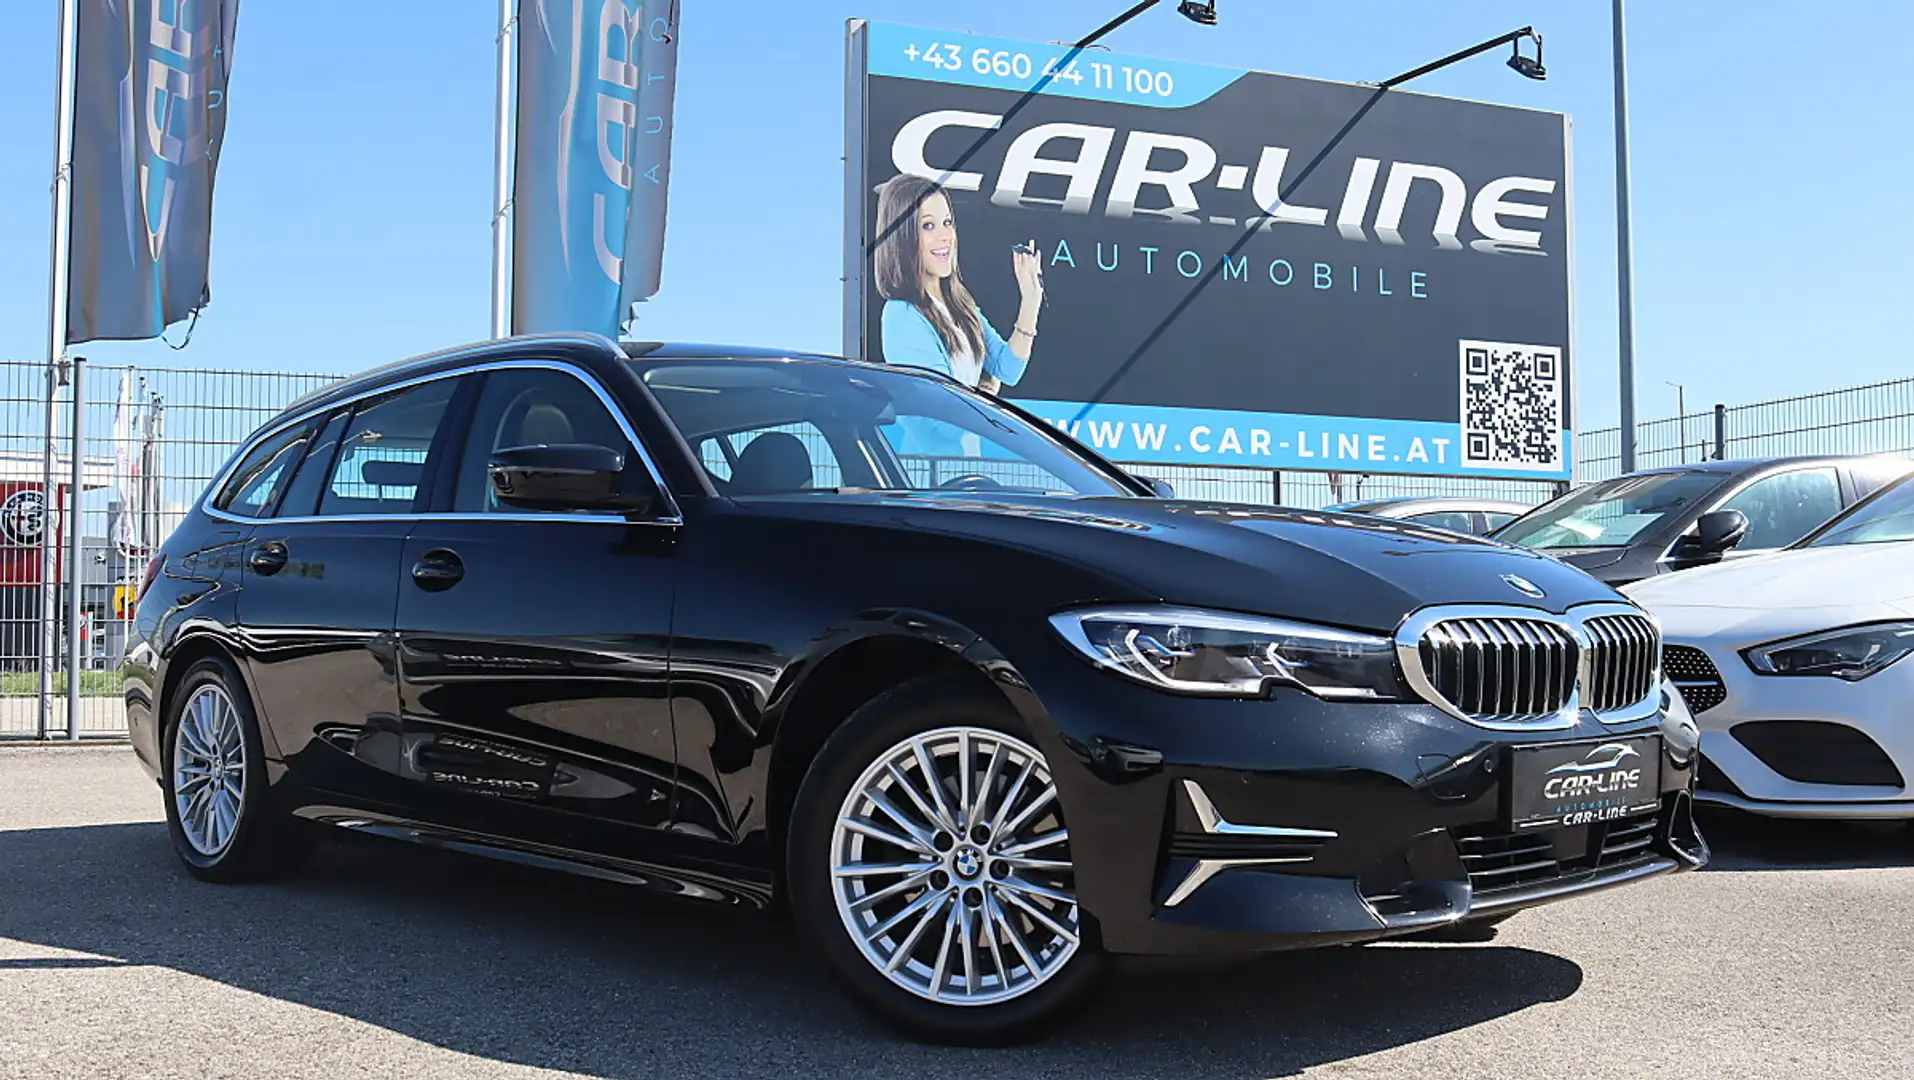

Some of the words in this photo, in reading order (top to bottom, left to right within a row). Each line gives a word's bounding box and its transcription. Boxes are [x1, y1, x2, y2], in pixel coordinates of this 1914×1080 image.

[903, 42, 962, 71] +43
[971, 48, 1032, 80] 660
[1041, 56, 1084, 86] 44
[1090, 62, 1115, 90] 11
[1121, 66, 1174, 97] 100
[890, 109, 1557, 246] CAR-LINE
[1050, 238, 1430, 299] AUTOMOBILE
[1544, 768, 1641, 799] CAR-LINE
[1563, 805, 1629, 826] CAR-LINE
